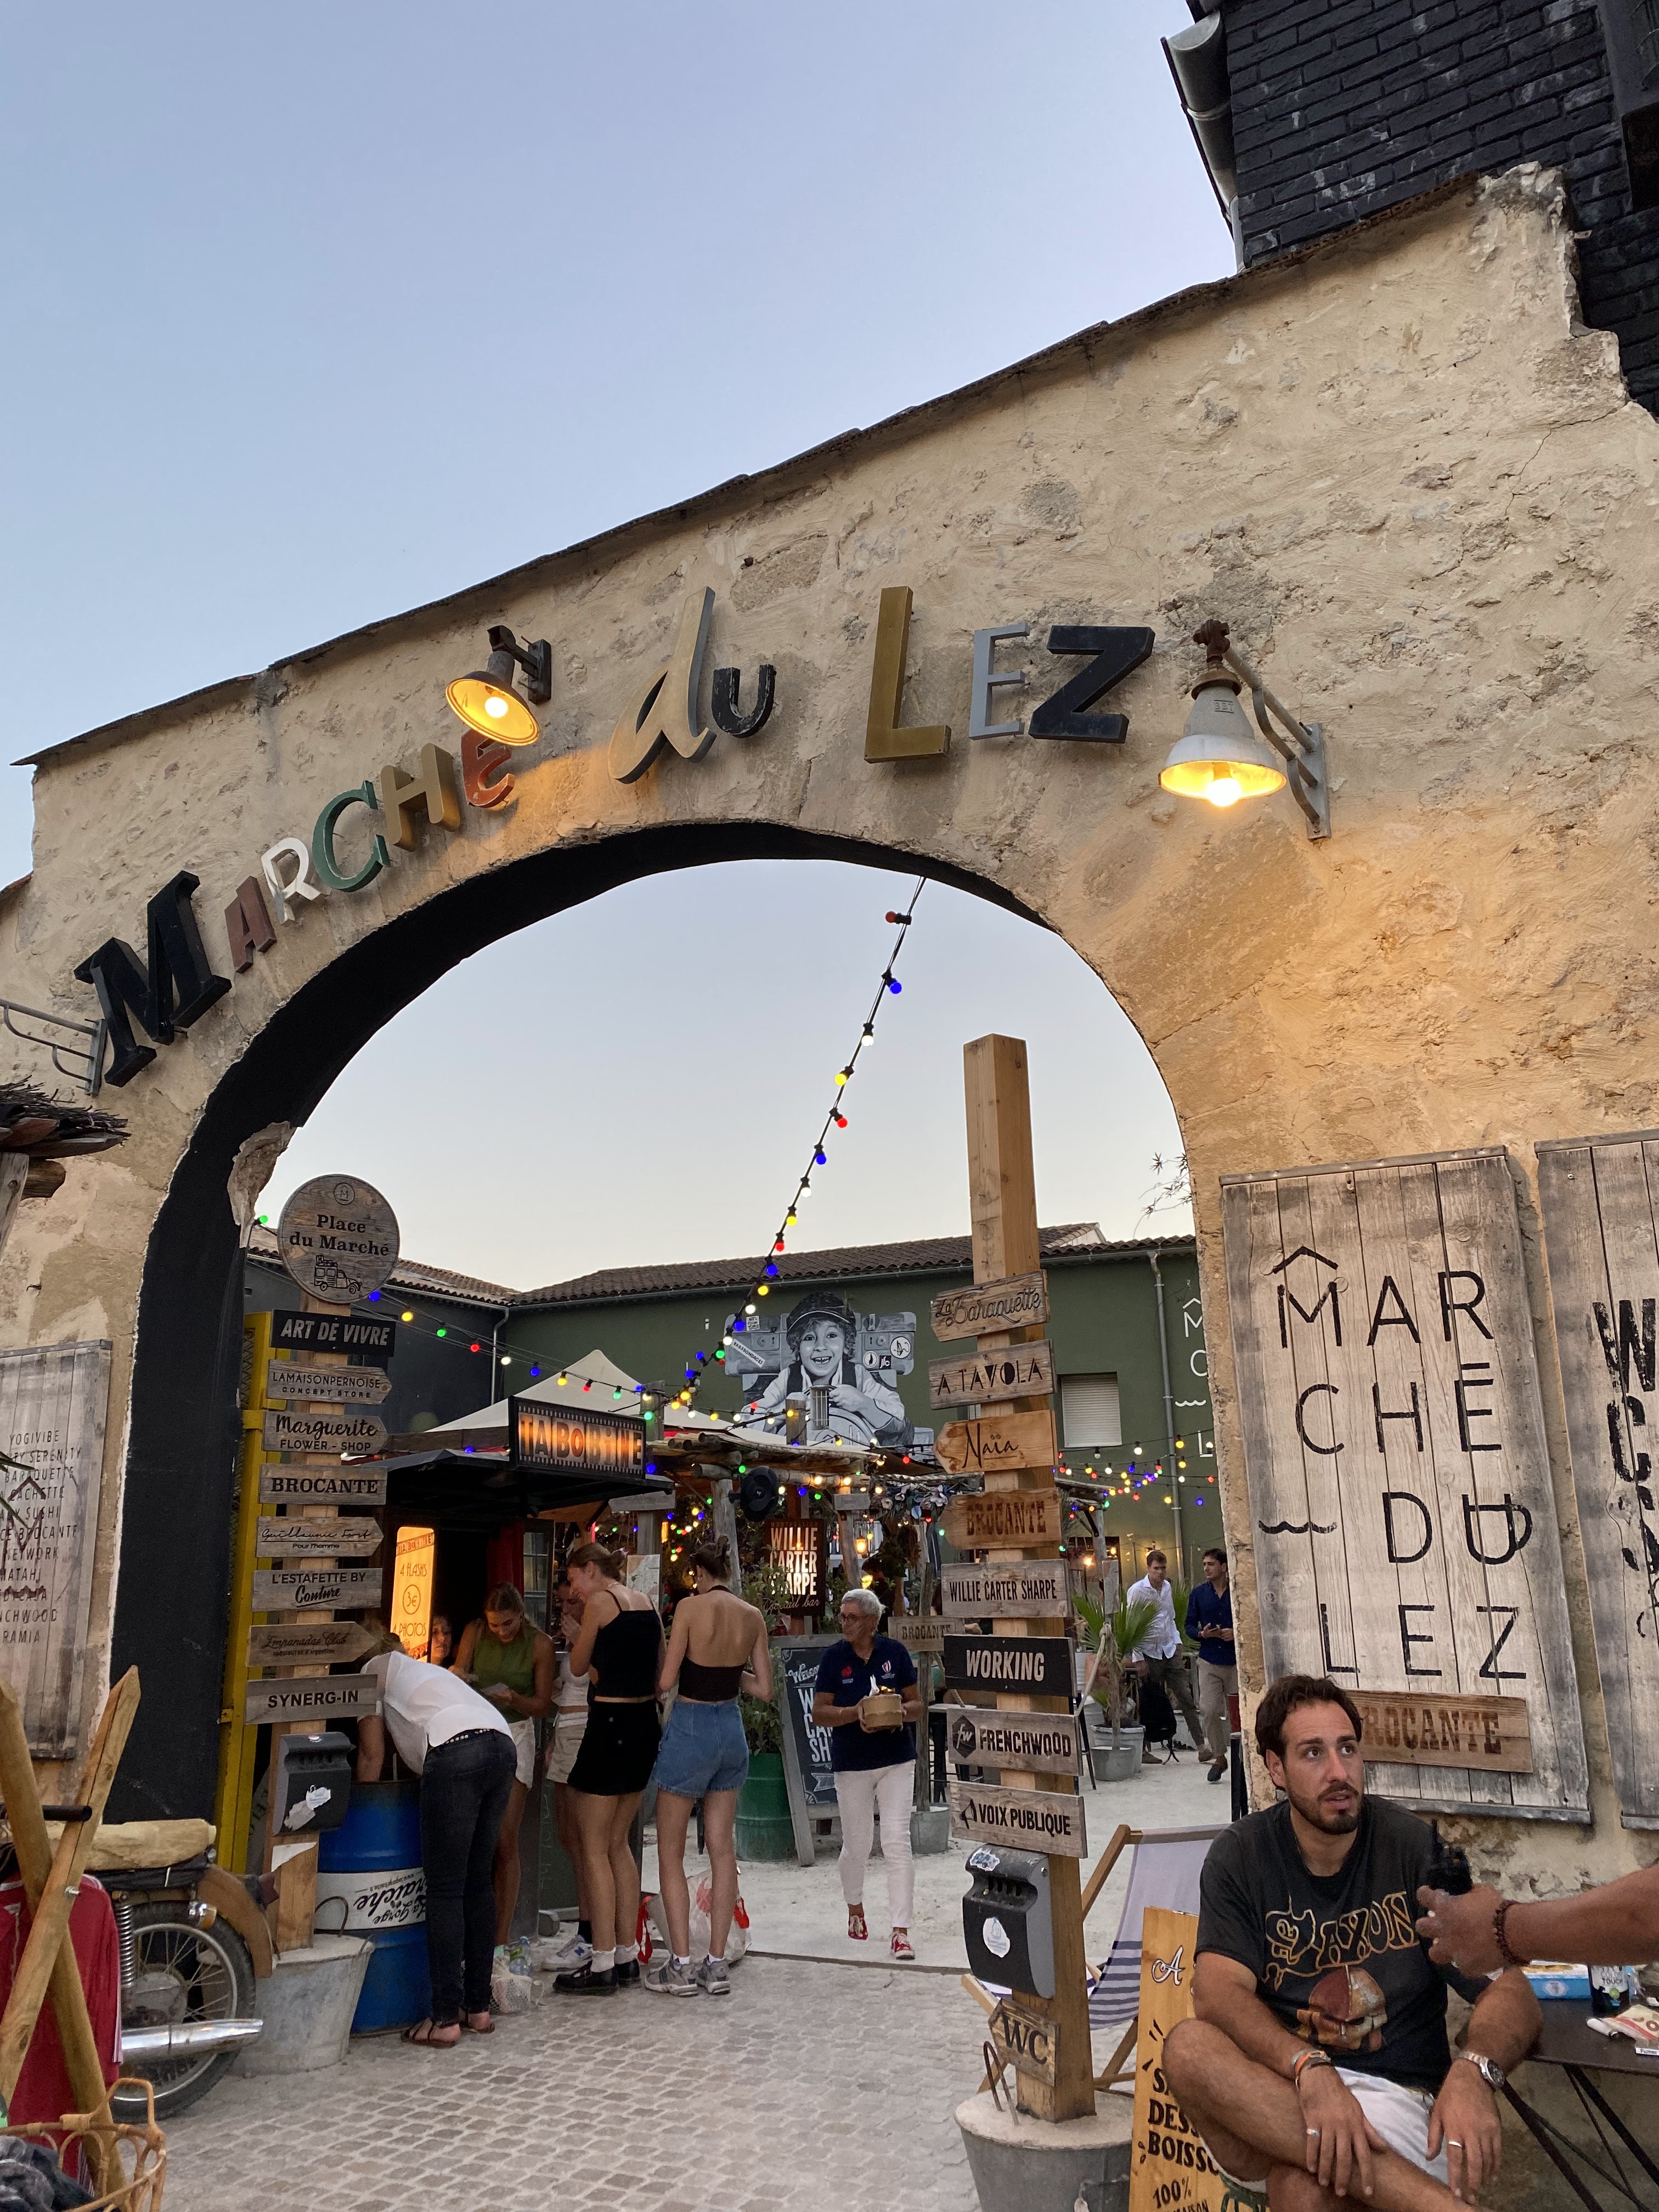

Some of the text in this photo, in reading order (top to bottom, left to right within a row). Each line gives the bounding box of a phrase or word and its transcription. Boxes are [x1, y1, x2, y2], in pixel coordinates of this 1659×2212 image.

[609, 585, 776, 784] du
[864, 585, 1155, 764] LEZ
[317, 1214, 366, 1233] Place
[289, 1231, 390, 1256] du Marché
[935, 1288, 1041, 1327] La Baraquette
[280, 1318, 391, 1346] ART DE VIVRE
[733, 1341, 763, 1365] VAGABONDAGES
[272, 1372, 381, 1389] LAMAISONPERNOISE
[938, 1358, 1043, 1396] A TAVOLA
[282, 1386, 371, 1398] CONCEPT STORE
[9, 1430, 59, 1445] YOGIVIBE
[275, 1414, 377, 1440] Marguerite
[280, 1438, 328, 1451] FLOWER
[340, 1442, 371, 1452] SHOP
[962, 1423, 1019, 1469] Naïa
[270, 1477, 378, 1495] BROCANTE
[967, 1500, 1047, 1536] BROCANTE
[1382, 1491, 1533, 1565] DU
[771, 1527, 817, 1551] WILLIE
[770, 1550, 817, 1573] CARTER
[272, 1572, 366, 1584] L'ESTAFETTE BY
[769, 1573, 817, 1595] ARPE
[295, 1582, 343, 1604] Couture
[407, 1592, 417, 1607] 3€
[802, 1594, 820, 1607] bar
[949, 1579, 1057, 1602] WILLIE CARTER SHARPE
[261, 1631, 351, 1650] Empanadas Club
[399, 1622, 426, 1638] PHOTOS
[1319, 1603, 1527, 1680] LEZ
[966, 1649, 1045, 1682] WORKING
[267, 1690, 358, 1708] SYNERG-IN
[1362, 1705, 1502, 1755] ROCANTE
[979, 1728, 1072, 1758] FRENCHWOOD
[978, 1803, 1071, 1837] VOIX PUBLIQUE
[1262, 1891, 1420, 1991] SAXON
[1002, 2014, 1048, 2065] WC
[1152, 2176, 1192, 2209] 100%
